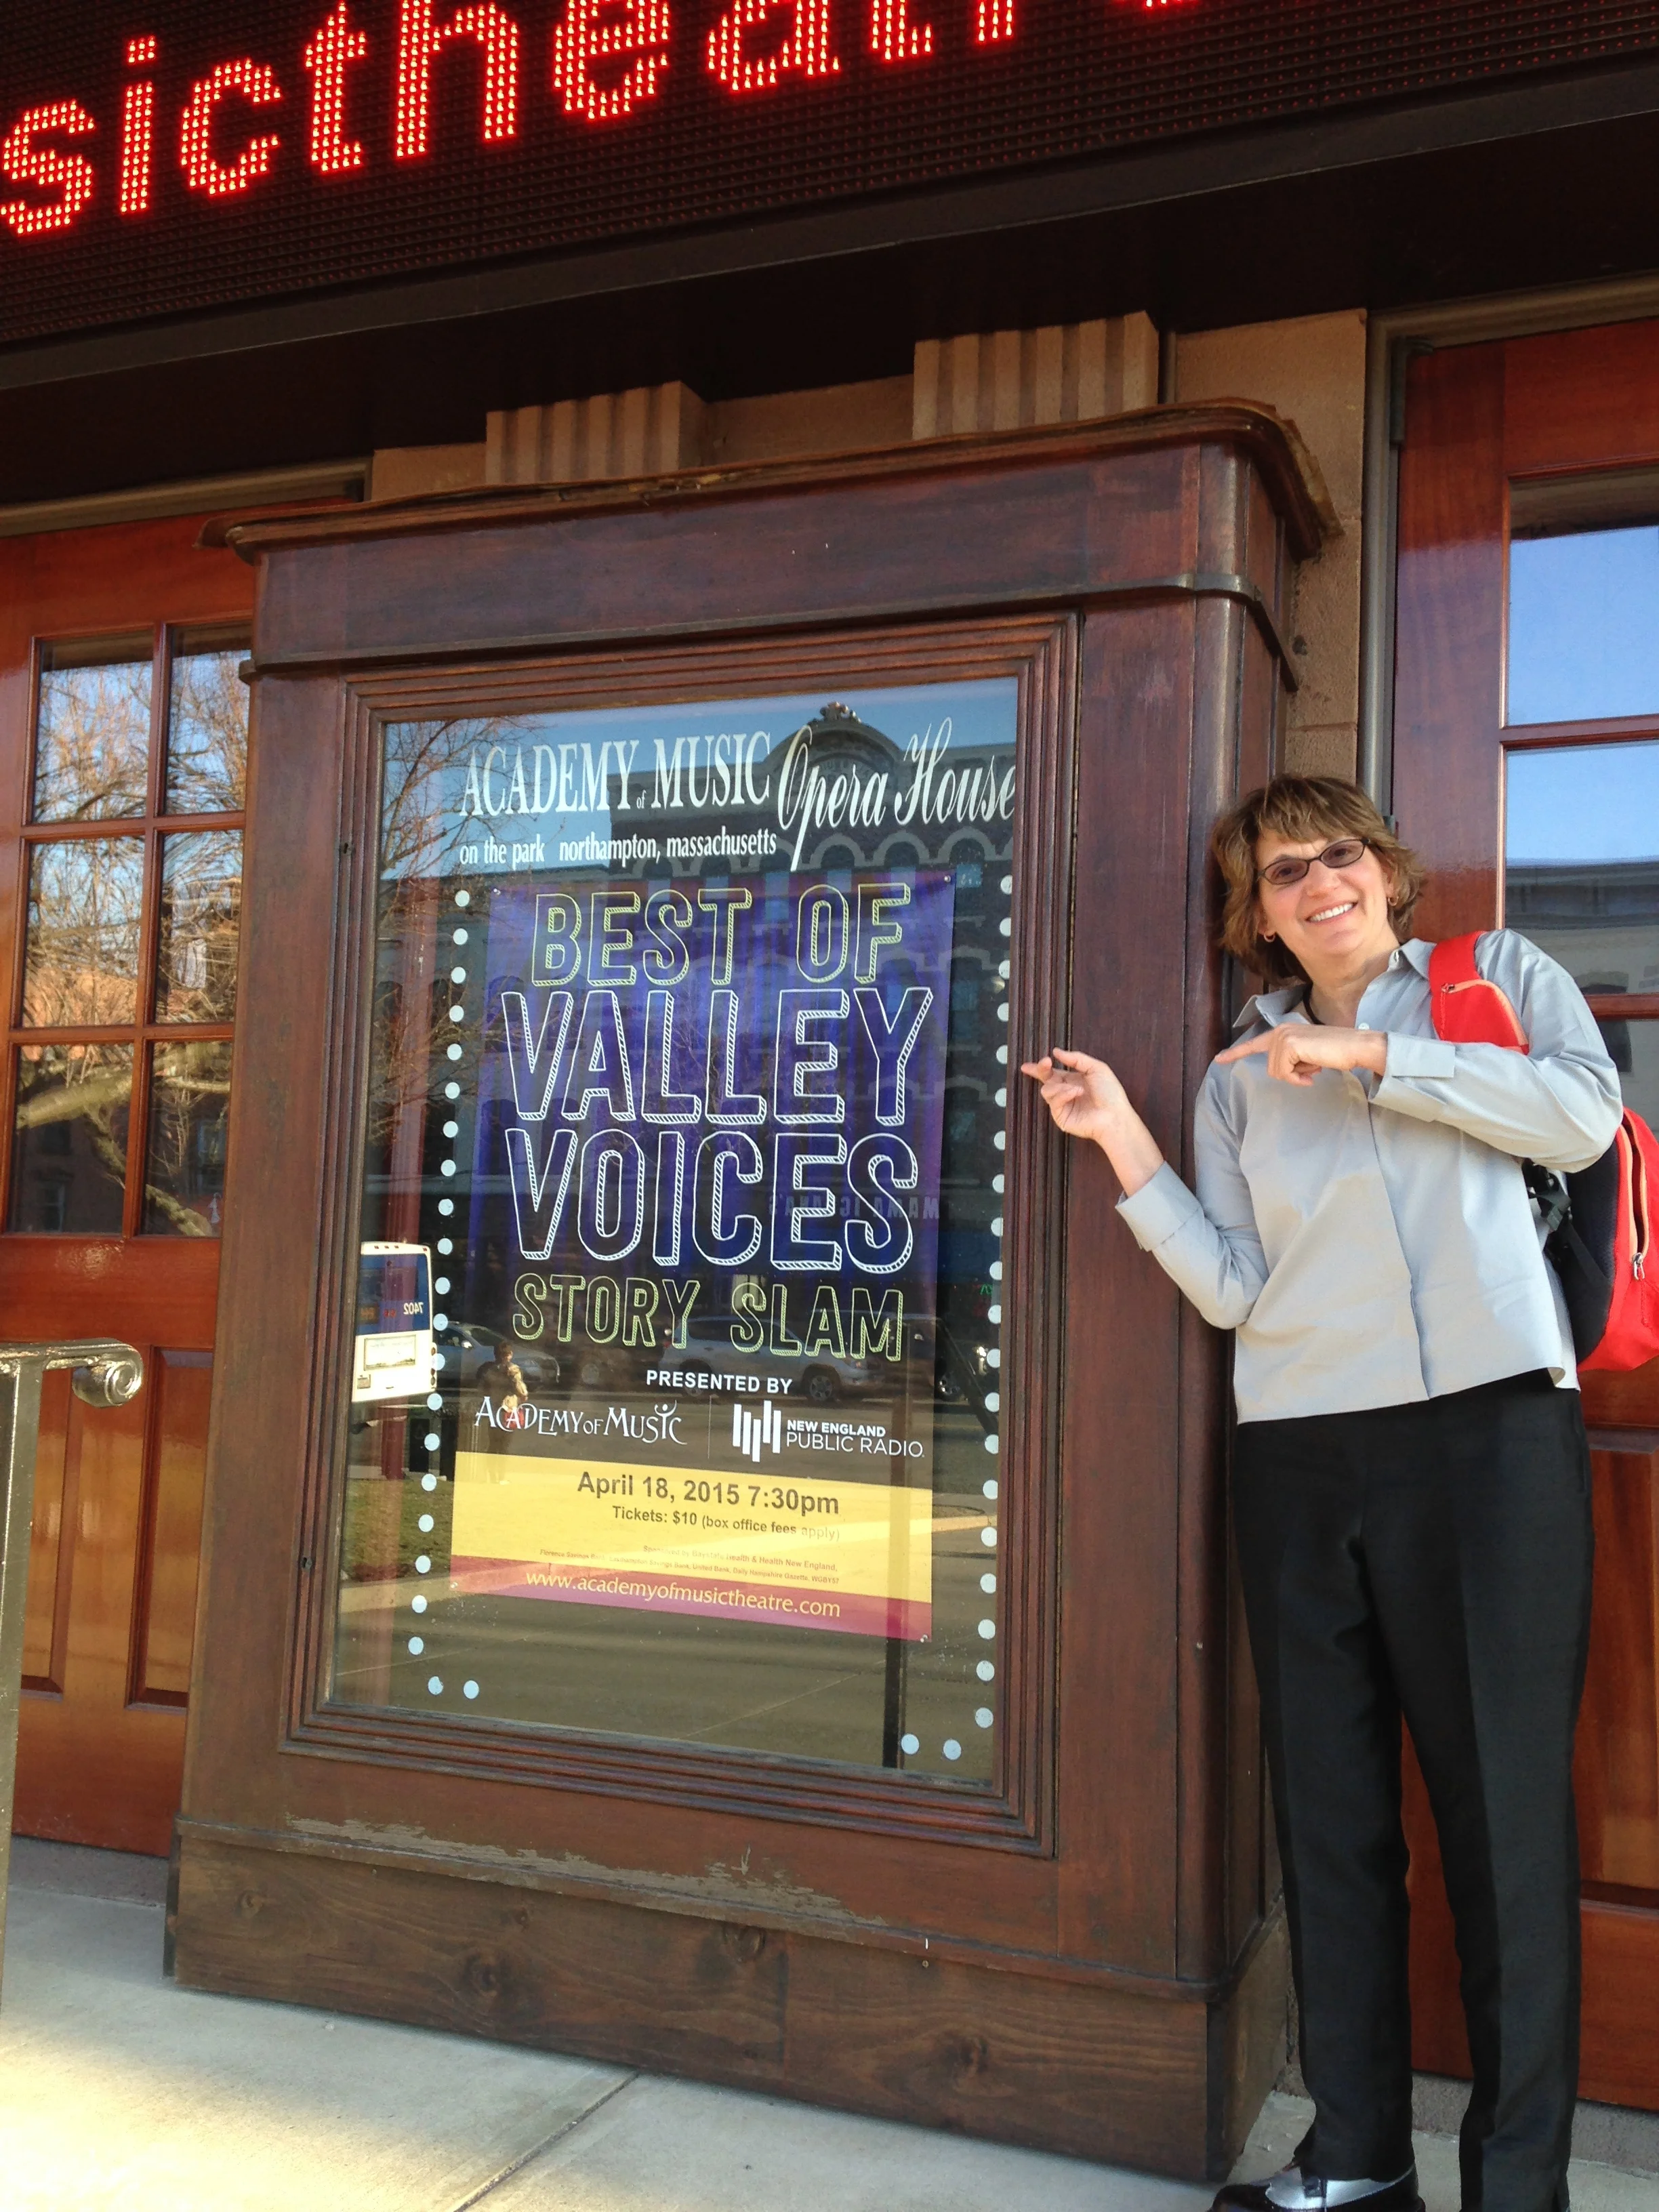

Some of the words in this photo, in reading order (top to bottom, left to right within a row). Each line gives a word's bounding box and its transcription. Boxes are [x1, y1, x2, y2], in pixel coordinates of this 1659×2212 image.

[0, 0, 1179, 234] sicthea
[461, 739, 639, 817] ACADEMY
[636, 790, 646, 809] of
[651, 730, 771, 811] MUSIC
[777, 724, 888, 872] Opera
[894, 716, 1016, 825] House
[459, 844, 478, 865] on
[483, 836, 507, 864] the
[512, 834, 545, 870] park
[559, 832, 661, 868] northampton,
[666, 825, 777, 858] massachusetts
[531, 888, 752, 987] BEST
[796, 883, 911, 983] OF
[501, 987, 933, 1126] VALLEY
[504, 1128, 919, 1274] VOICES
[512, 1273, 701, 1350] STORY
[730, 1282, 903, 1362] SLAM
[645, 1370, 760, 1393] PRESENTED
[766, 1377, 793, 1395] BY
[474, 1396, 583, 1436] ACADEMY
[604, 1399, 688, 1445] MUSIC
[786, 1432, 854, 1452] PUBLIC
[787, 1419, 819, 1433] NEW
[821, 1422, 886, 1437] ENGLAND
[577, 1471, 634, 1499] April
[642, 1476, 675, 1503] 18,
[683, 1480, 740, 1506] 2015
[747, 1486, 840, 1517] 7:30pm
[613, 1505, 668, 1523] Tickets:
[672, 1511, 697, 1525] $10
[702, 1515, 729, 1530] (box
[733, 1518, 767, 1533] office
[771, 1521, 797, 1535] fees
[801, 1526, 840, 1542] apply)
[693, 1563, 712, 1572] United
[733, 1567, 748, 1576] Daily
[750, 1570, 783, 1579] Hampshire
[812, 1575, 840, 1584] WGBY57
[759, 1556, 783, 1566] Health
[785, 1559, 802, 1568] New
[804, 1561, 838, 1572] England,
[525, 1573, 840, 1618] www.academyofmusictheatre.com
